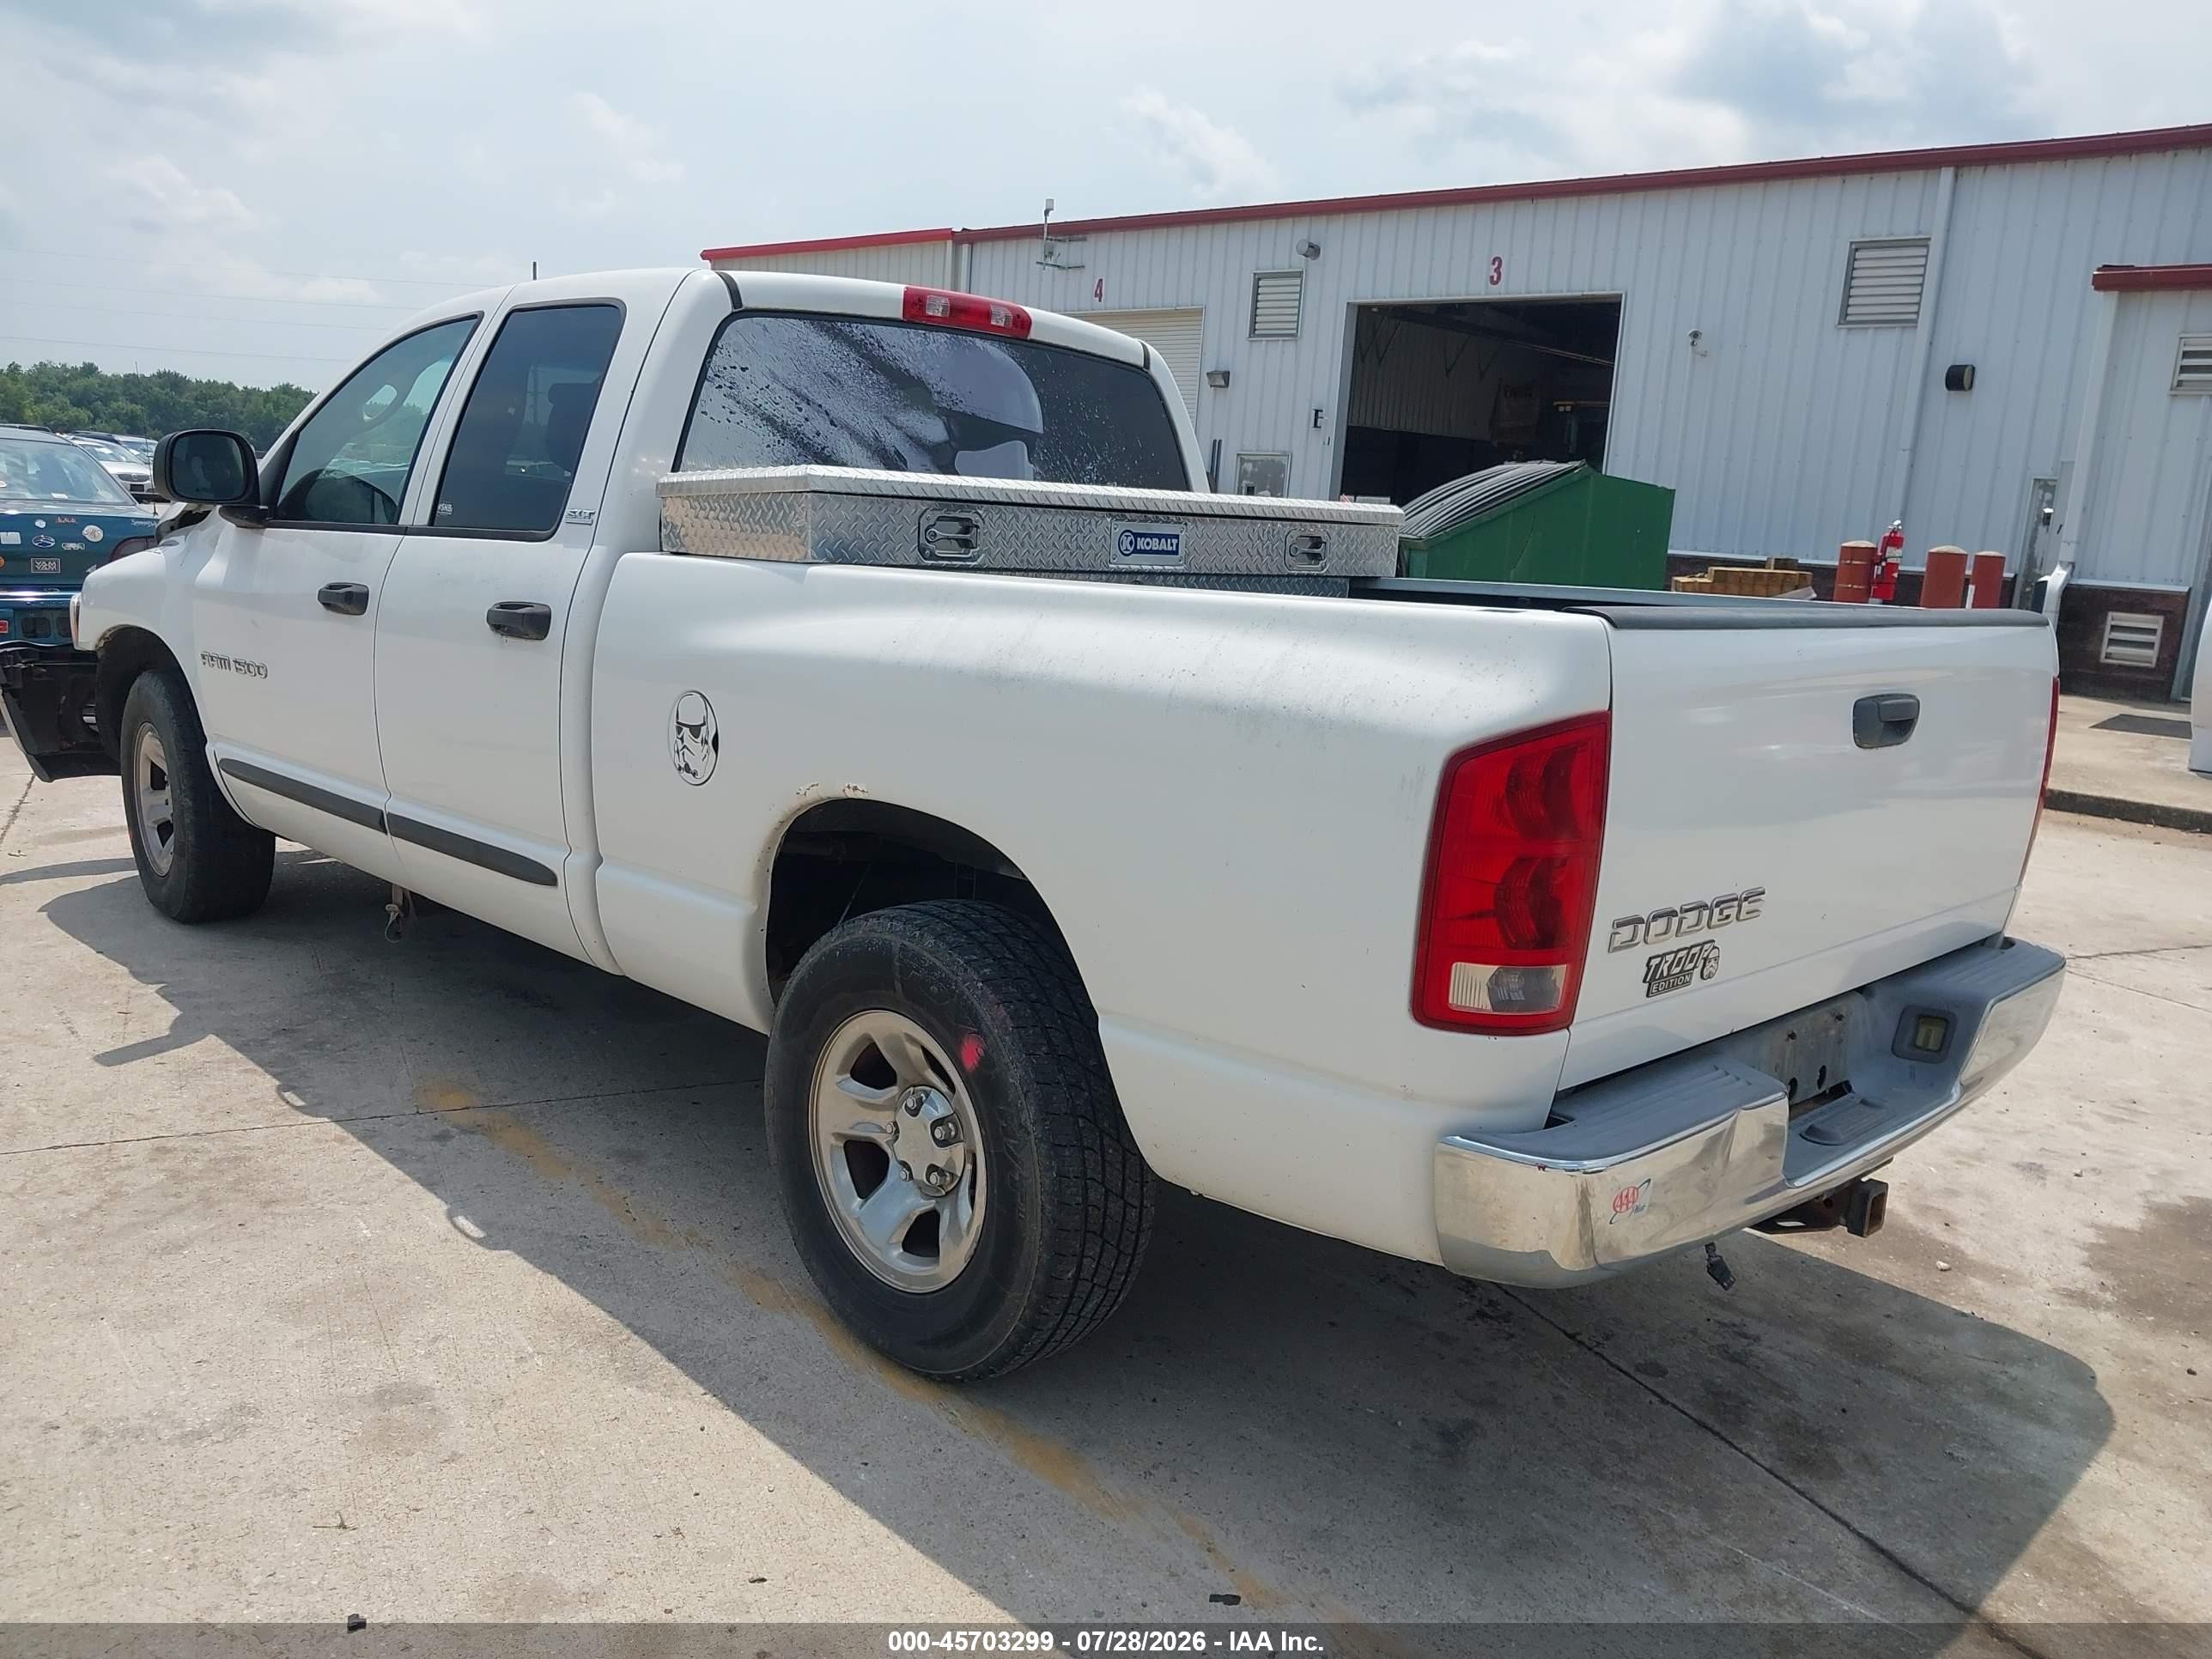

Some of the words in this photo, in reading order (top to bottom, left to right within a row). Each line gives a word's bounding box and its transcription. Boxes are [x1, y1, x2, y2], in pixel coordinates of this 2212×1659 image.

[1490, 256, 1503, 285] 3
[1094, 277, 1103, 302] 4
[1136, 537, 1178, 550] KOBALT
[200, 651, 231, 672] RAM
[233, 659, 268, 679] 1500
[1607, 886, 1765, 953] DODGE
[1644, 940, 1716, 983] TROOP
[1650, 973, 1692, 994] EDITION
